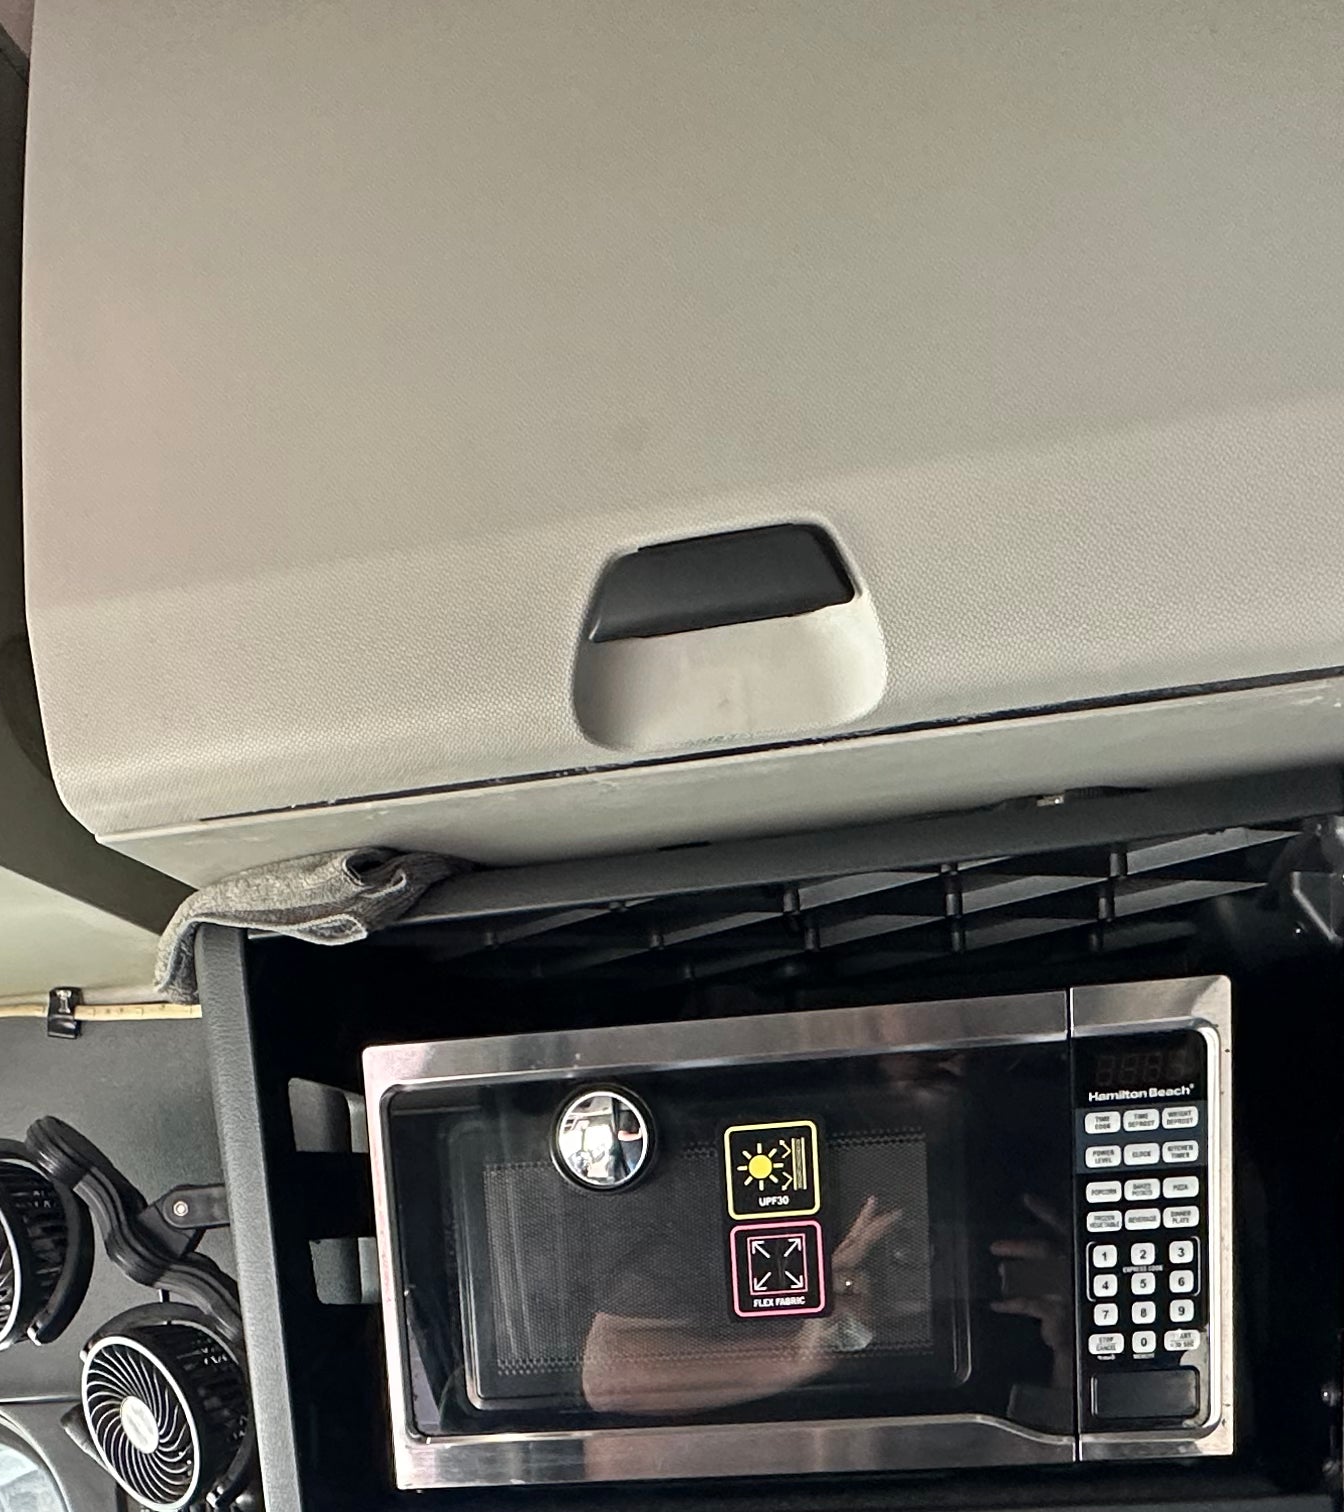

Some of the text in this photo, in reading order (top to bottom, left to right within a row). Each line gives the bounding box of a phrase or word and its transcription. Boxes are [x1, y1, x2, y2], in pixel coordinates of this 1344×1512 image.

[1088, 1085, 1190, 1102] Hamilton Beach
[758, 1196, 790, 1207] UPF30
[1140, 1250, 1147, 1260] 2
[1178, 1248, 1185, 1258] 3
[1102, 1281, 1109, 1290] 4
[1140, 1278, 1147, 1288] 5
[1178, 1276, 1185, 1286] 6
[753, 1296, 806, 1308] FLEX FABRIC
[1102, 1310, 1109, 1320] 7
[1140, 1308, 1147, 1318] 8
[1178, 1306, 1185, 1316] 9
[1140, 1338, 1147, 1347] 0
